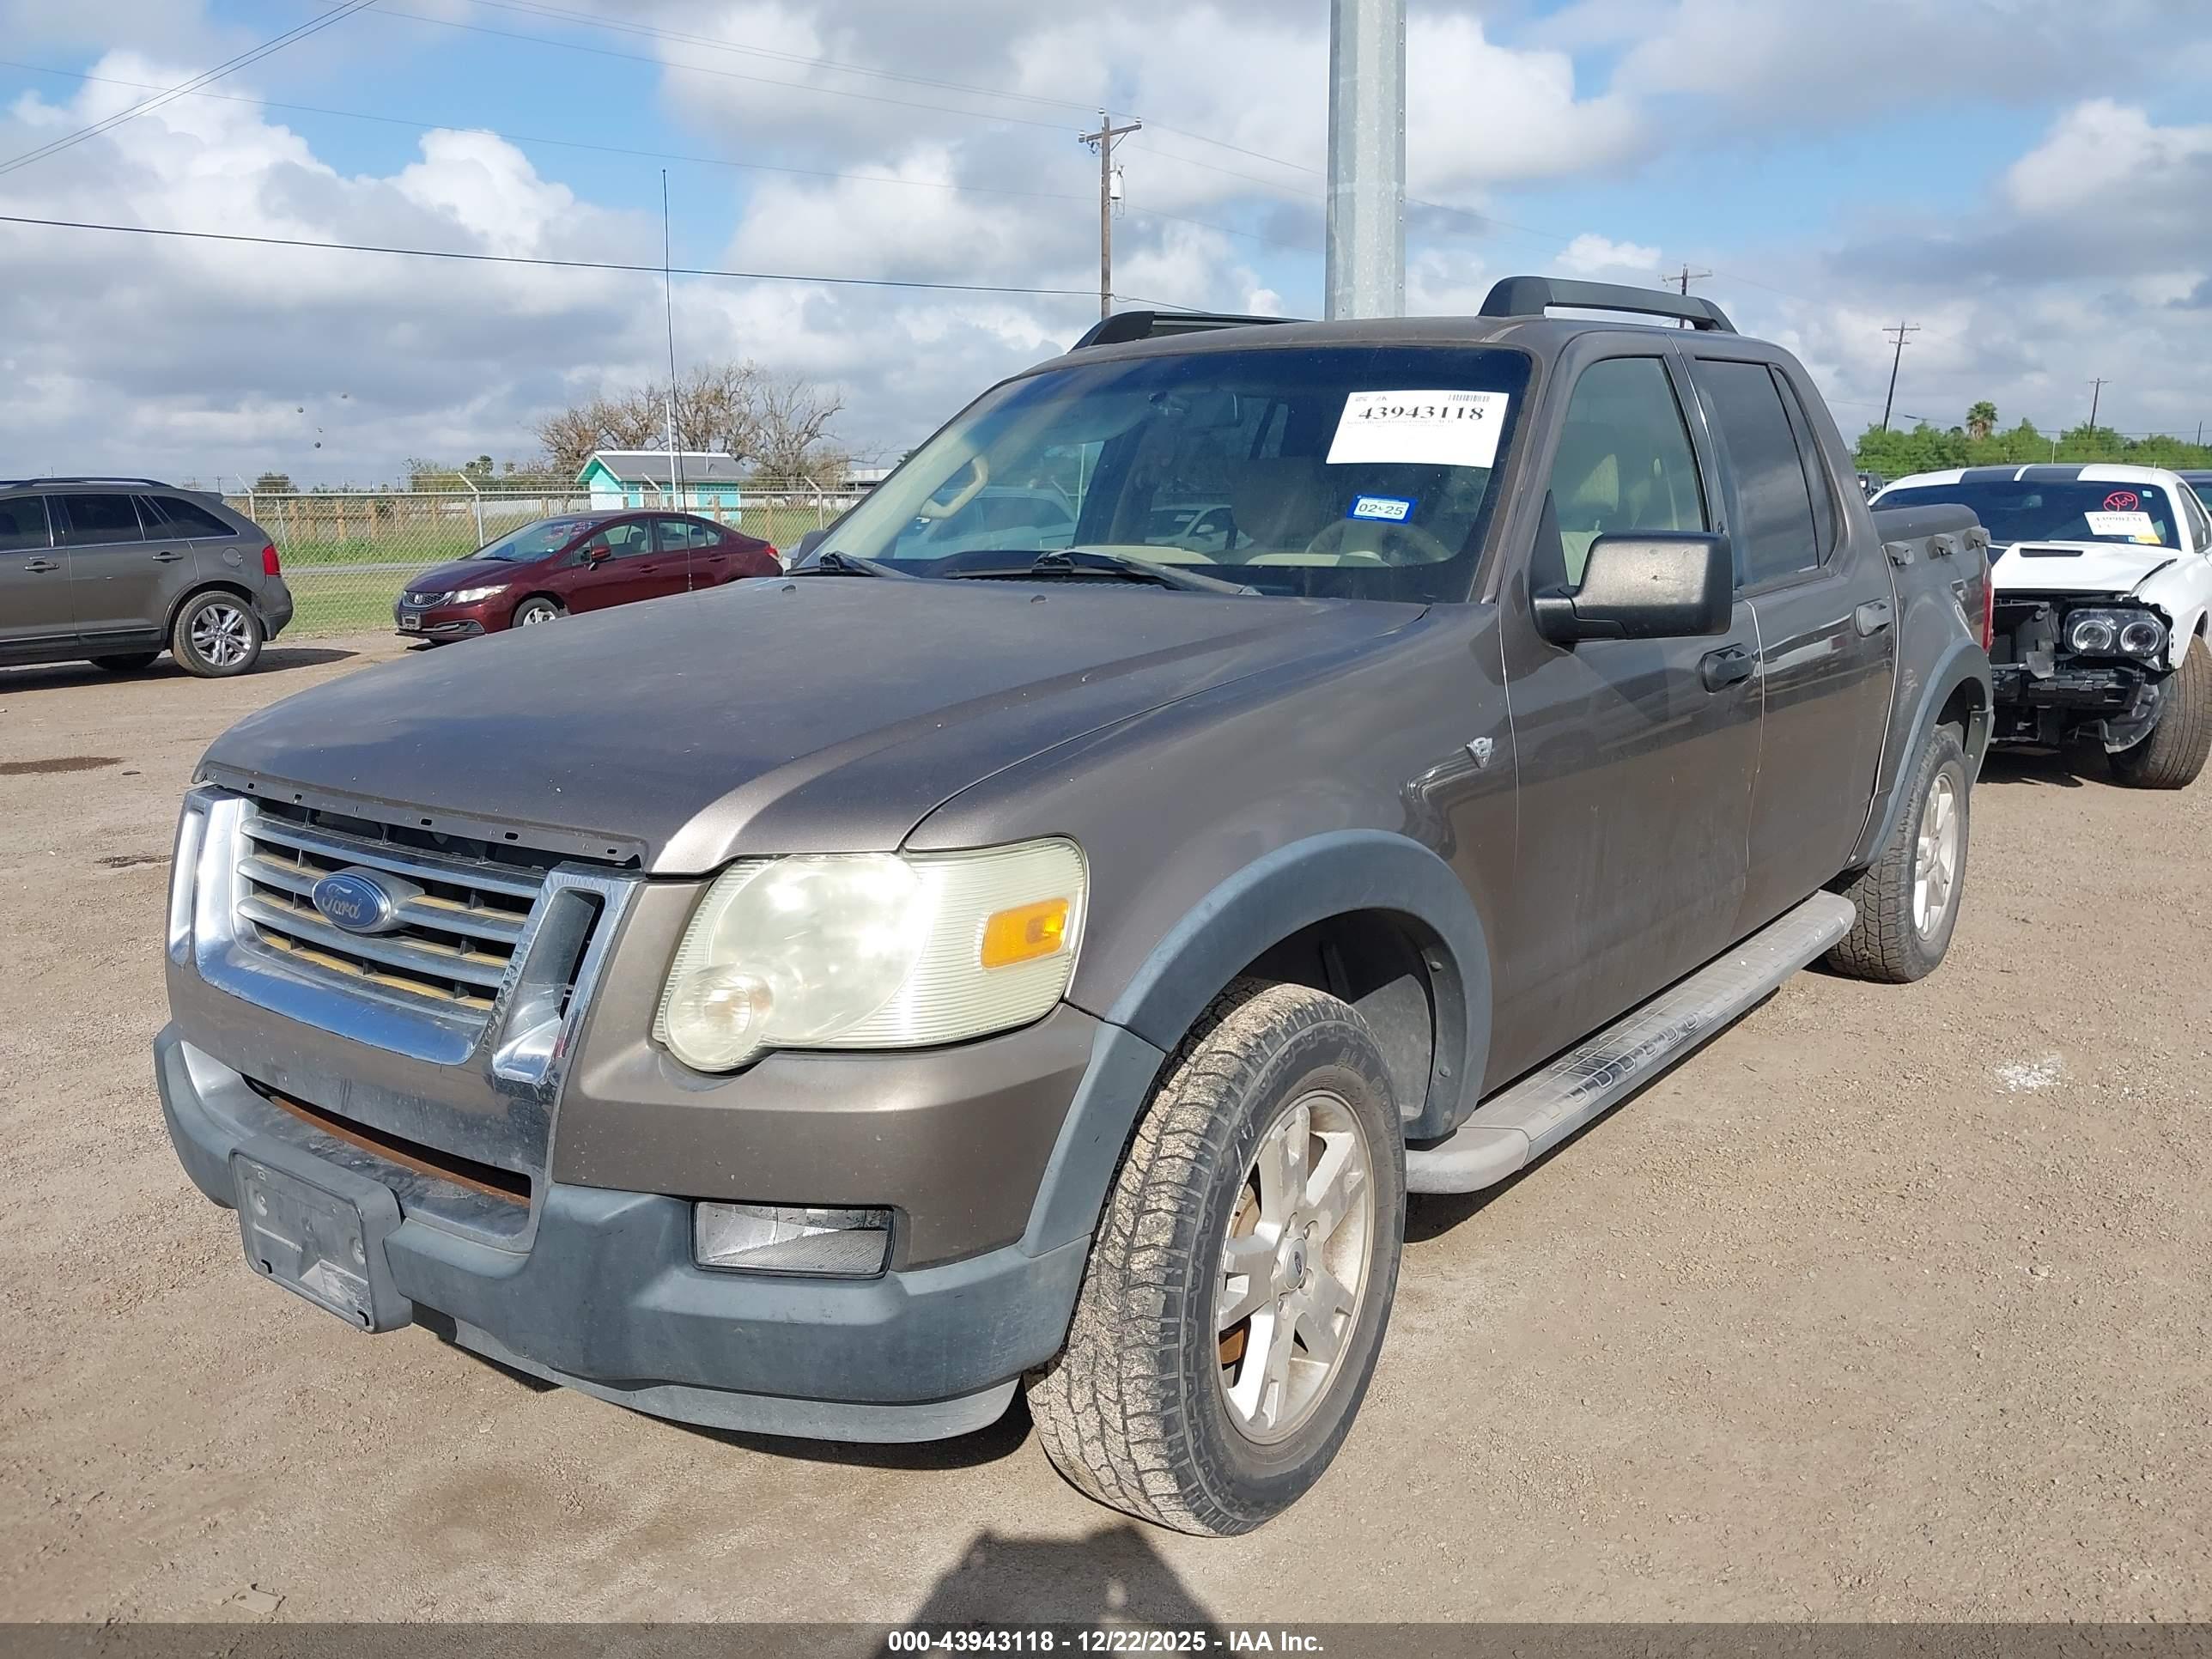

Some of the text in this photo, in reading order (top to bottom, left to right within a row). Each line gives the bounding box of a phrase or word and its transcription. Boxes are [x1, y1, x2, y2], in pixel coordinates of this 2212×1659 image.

[1358, 406, 1485, 421] 43943118
[1358, 503, 1404, 516] 02 25
[321, 882, 363, 920] Ford
